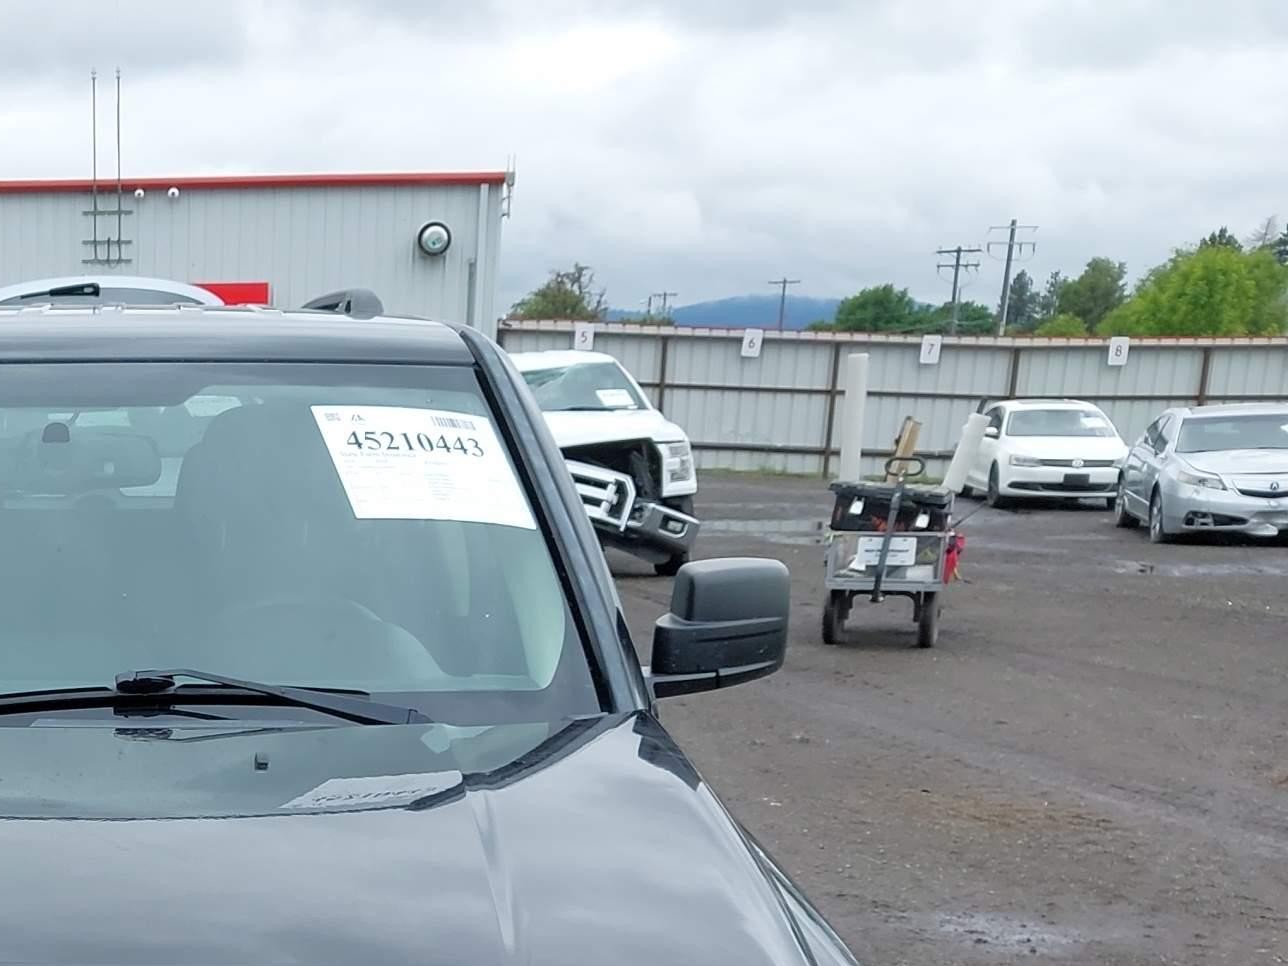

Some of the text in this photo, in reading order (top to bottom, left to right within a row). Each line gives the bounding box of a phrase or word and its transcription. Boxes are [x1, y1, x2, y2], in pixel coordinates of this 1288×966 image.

[580, 332, 588, 343] 5
[748, 338, 756, 349] 6
[927, 343, 935, 355] 7
[1115, 345, 1122, 357] 8
[346, 430, 485, 458] 45210443
